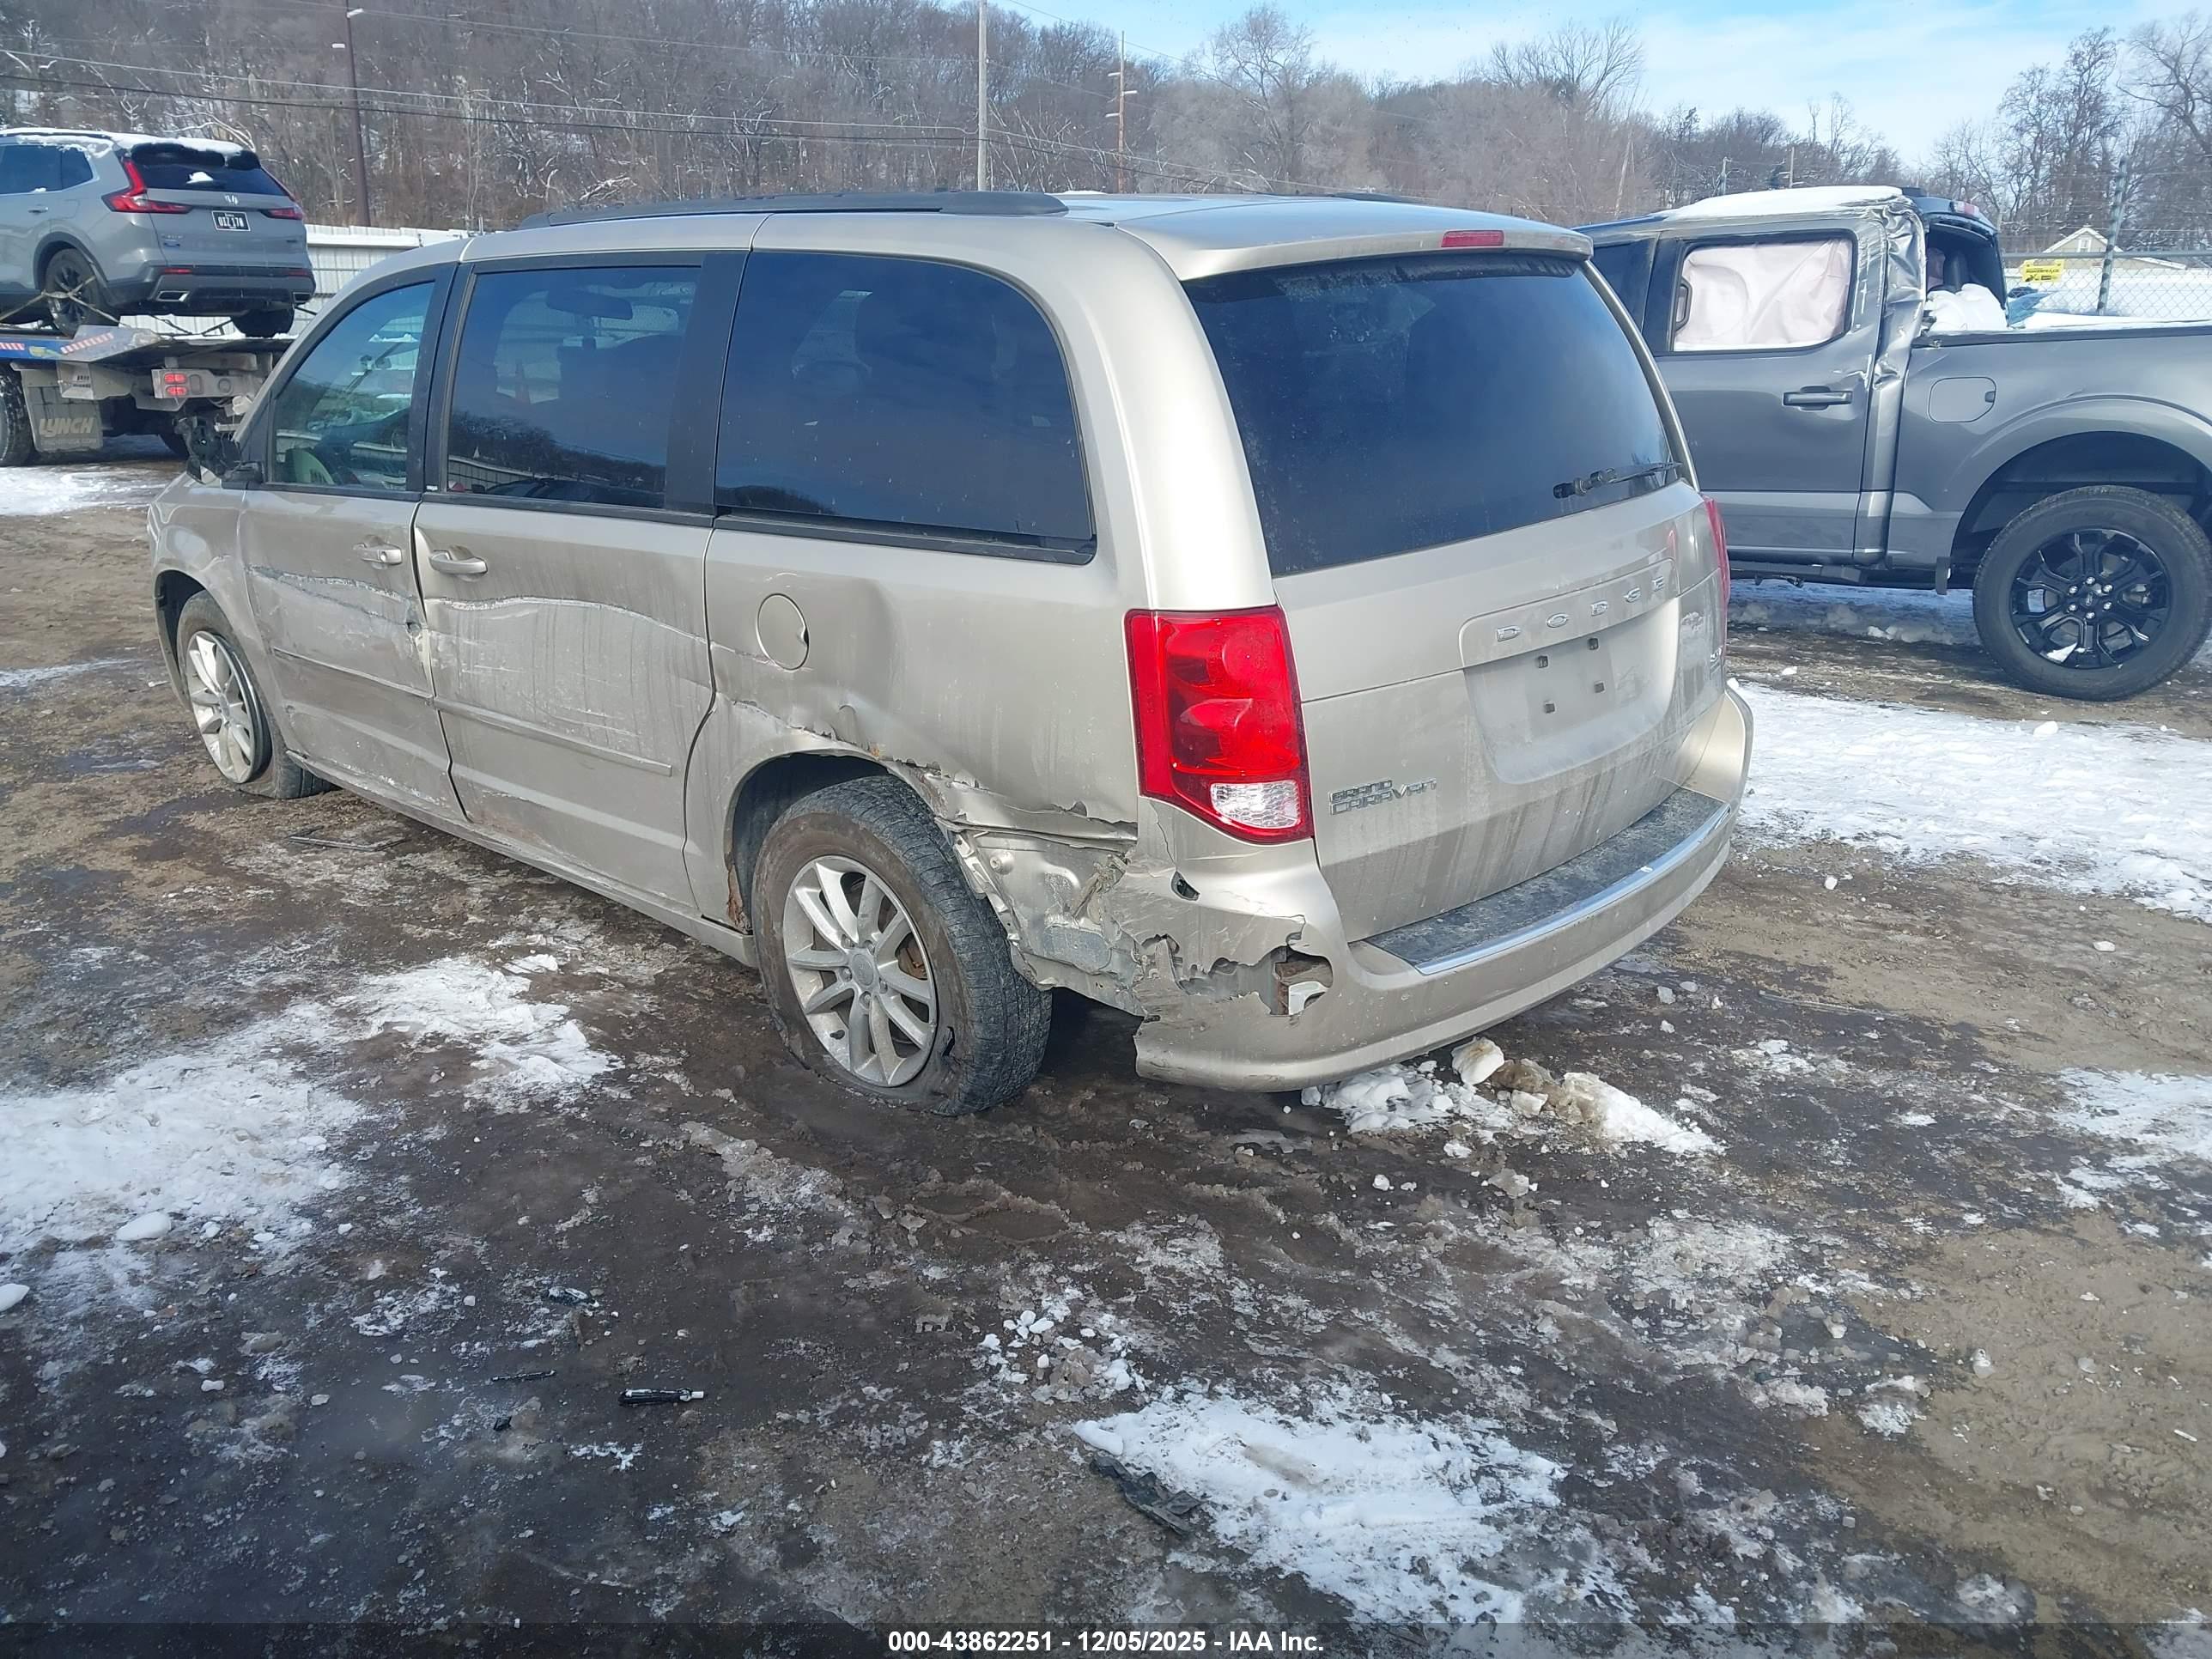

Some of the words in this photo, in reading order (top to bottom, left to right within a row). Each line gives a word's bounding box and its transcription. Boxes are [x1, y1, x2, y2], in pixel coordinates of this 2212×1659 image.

[40, 417, 95, 438] LYNCH
[1496, 576, 1664, 642] DODGE
[1328, 779, 1393, 804] GRAND
[1329, 777, 1437, 816] CARAVAN
